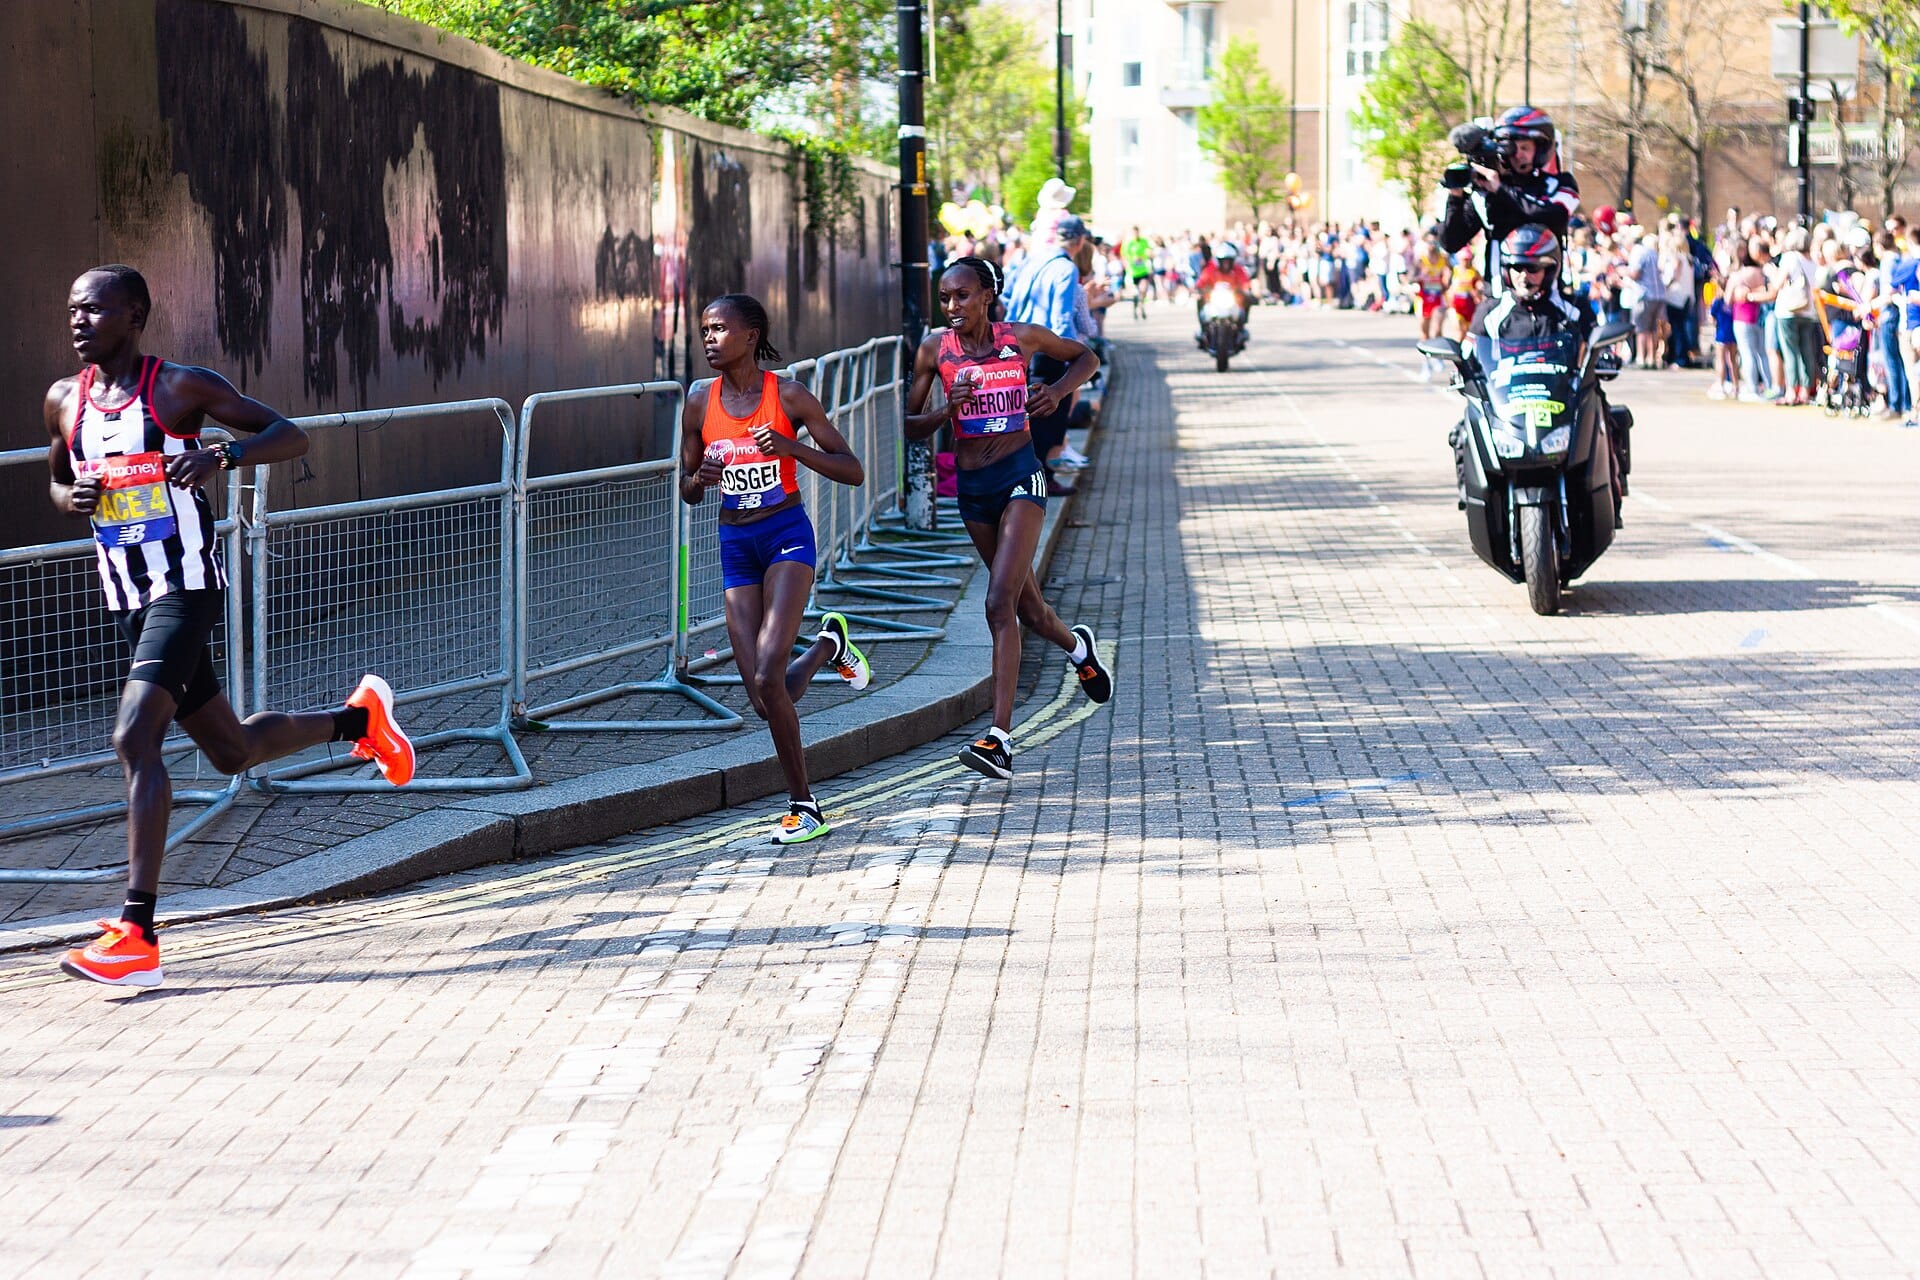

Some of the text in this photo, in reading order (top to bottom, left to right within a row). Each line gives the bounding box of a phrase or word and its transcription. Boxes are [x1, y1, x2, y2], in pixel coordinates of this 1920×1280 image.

[986, 369, 1021, 381] money
[961, 388, 1022, 416] CHERONO
[1538, 411, 1548, 422] 2
[736, 444, 760, 456] mon
[111, 462, 158, 477] money
[150, 486, 167, 513] 4
